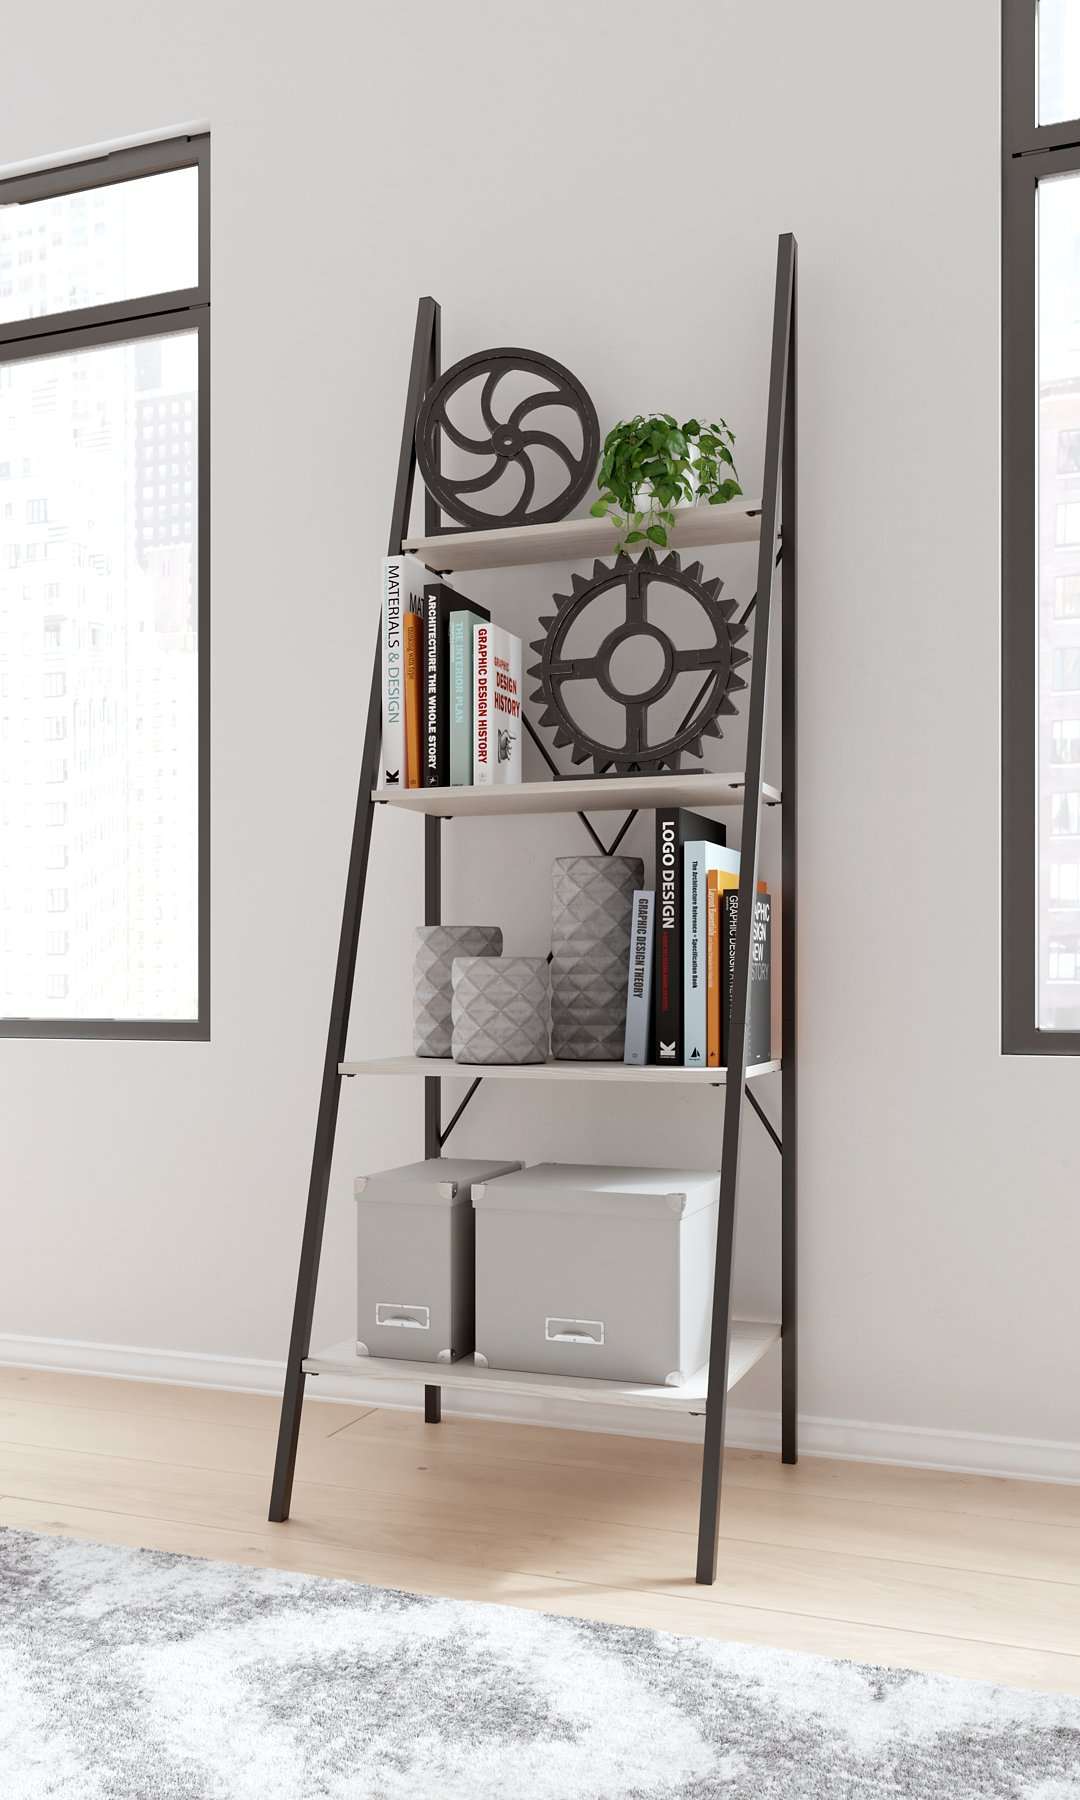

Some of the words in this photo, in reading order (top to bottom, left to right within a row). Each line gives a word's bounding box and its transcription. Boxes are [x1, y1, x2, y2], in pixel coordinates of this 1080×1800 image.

[388, 565, 399, 648] MATERIALS
[428, 595, 437, 672] ARCHITECTURE
[478, 628, 487, 676] GRAPHIC
[388, 652, 399, 662] &
[388, 668, 400, 723] DESIGN
[428, 673, 437, 694] THE
[478, 678, 487, 717] DESIGN
[496, 671, 517, 695] DESIGN
[428, 696, 437, 733] WHOLE
[494, 691, 520, 718] HISTORY
[428, 735, 437, 769] STORY
[478, 719, 487, 764] HISTORY
[662, 821, 675, 867] LOGO
[636, 898, 649, 935] GRAPHIC
[662, 870, 675, 929] DESIGN
[729, 895, 739, 936] GRAPHIC
[634, 936, 647, 966] DESIGN
[633, 967, 645, 999] THEORY
